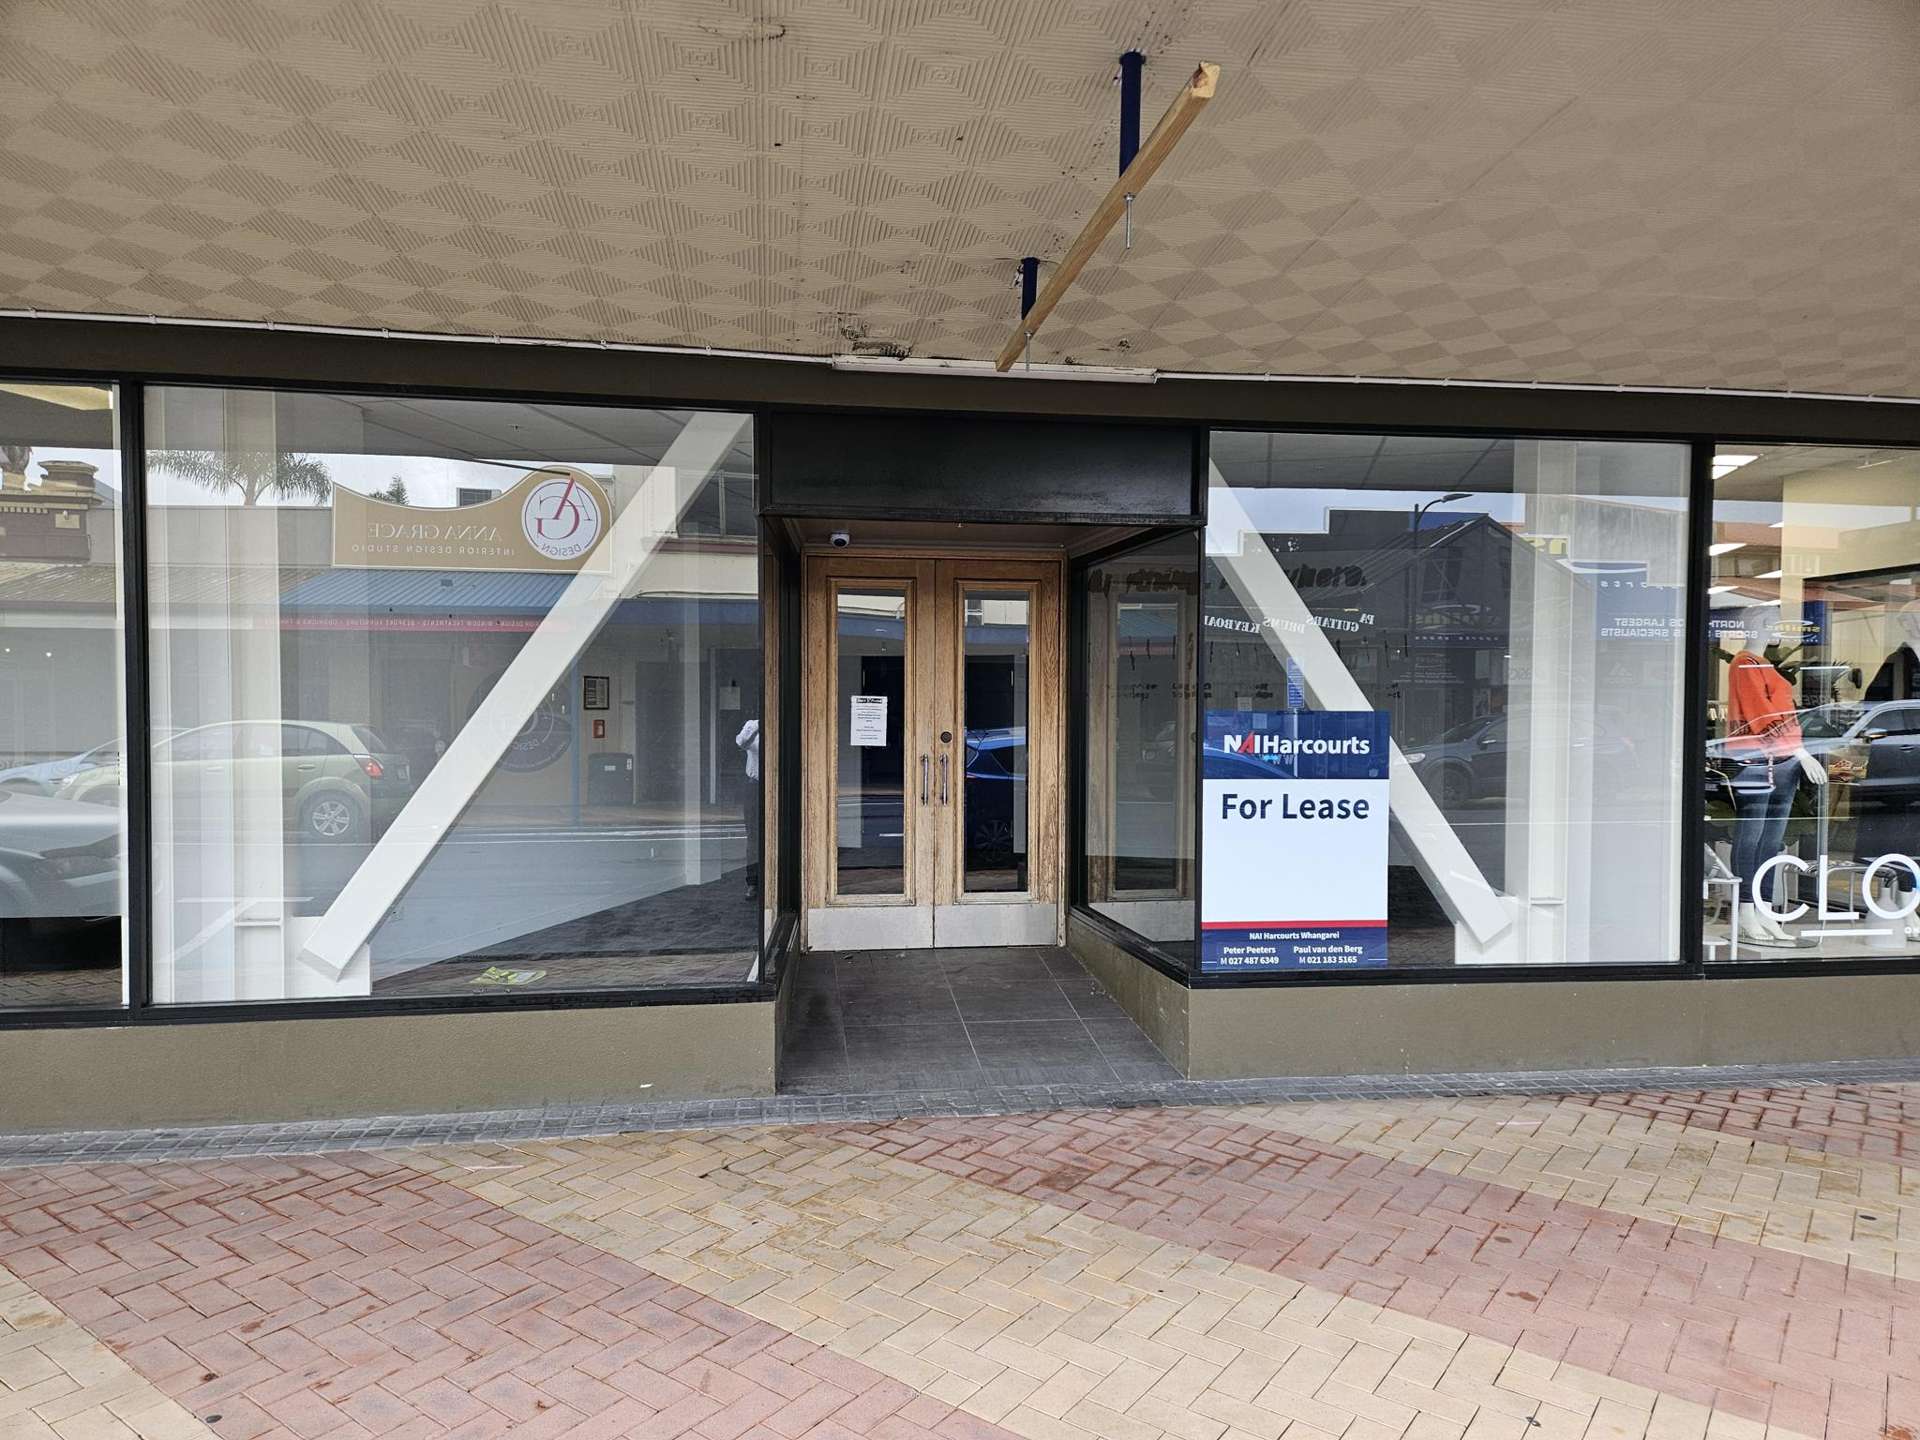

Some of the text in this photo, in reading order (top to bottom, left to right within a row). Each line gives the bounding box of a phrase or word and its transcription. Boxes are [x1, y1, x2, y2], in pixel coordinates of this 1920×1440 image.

[1263, 735, 1370, 754] Harcourts
[1222, 793, 1369, 819] For Lease
[1752, 853, 1920, 921] CLO
[1249, 931, 1339, 941] NAI Harcourts Whangarei
[1223, 946, 1276, 954] Peter Peeters
[1294, 945, 1312, 953] Paul
[1328, 945, 1343, 953] den
[1344, 945, 1363, 954] Berg
[1220, 956, 1279, 965] M 027 487 6349
[1299, 956, 1357, 964] M 021 183 5165
